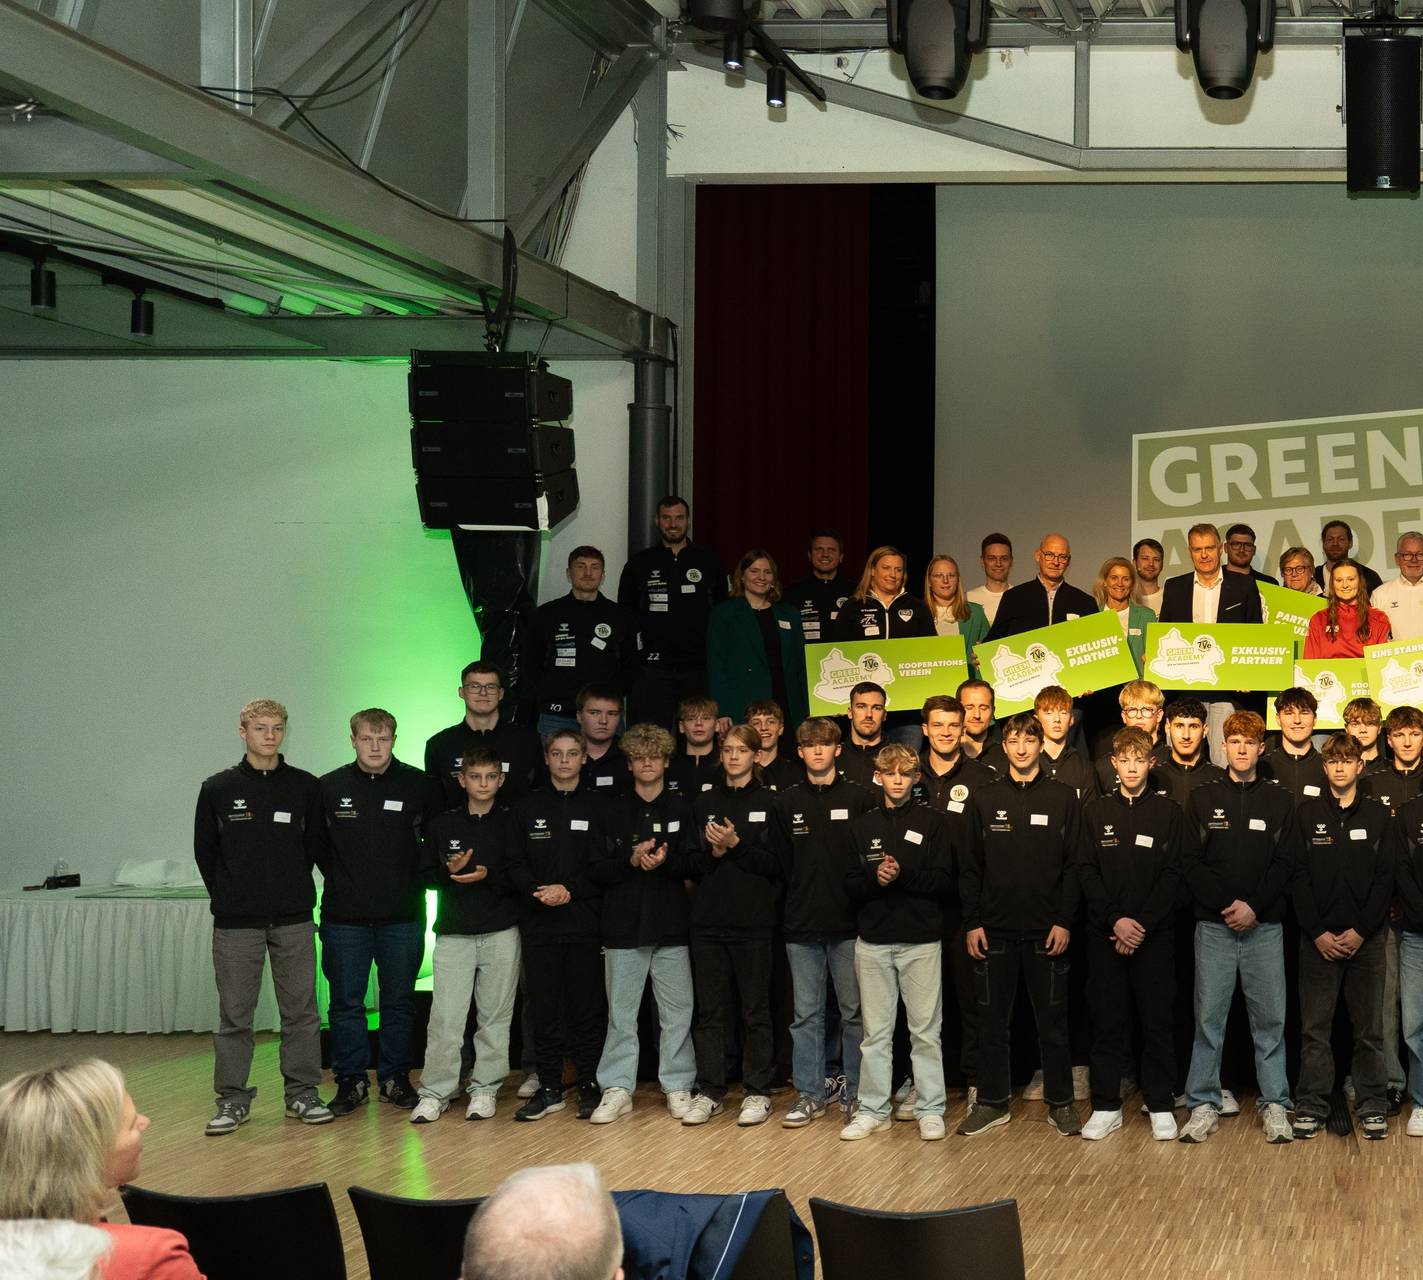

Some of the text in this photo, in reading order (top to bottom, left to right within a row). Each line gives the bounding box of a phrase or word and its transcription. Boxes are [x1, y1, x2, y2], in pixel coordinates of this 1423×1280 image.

[1150, 426, 1423, 507] GREEN
[1065, 635, 1123, 657] EXKLUSIV-
[1231, 647, 1291, 656] EXKLUSIV-
[1069, 646, 1120, 667] PARTNER
[1372, 647, 1393, 659] EINE
[862, 659, 879, 670] TVe
[898, 659, 967, 669] KOOPERATIONS-
[1231, 656, 1283, 665] PARTNER
[831, 668, 860, 679] GREEN
[899, 669, 932, 677] VEREIN
[832, 674, 873, 685] ACADEMY
